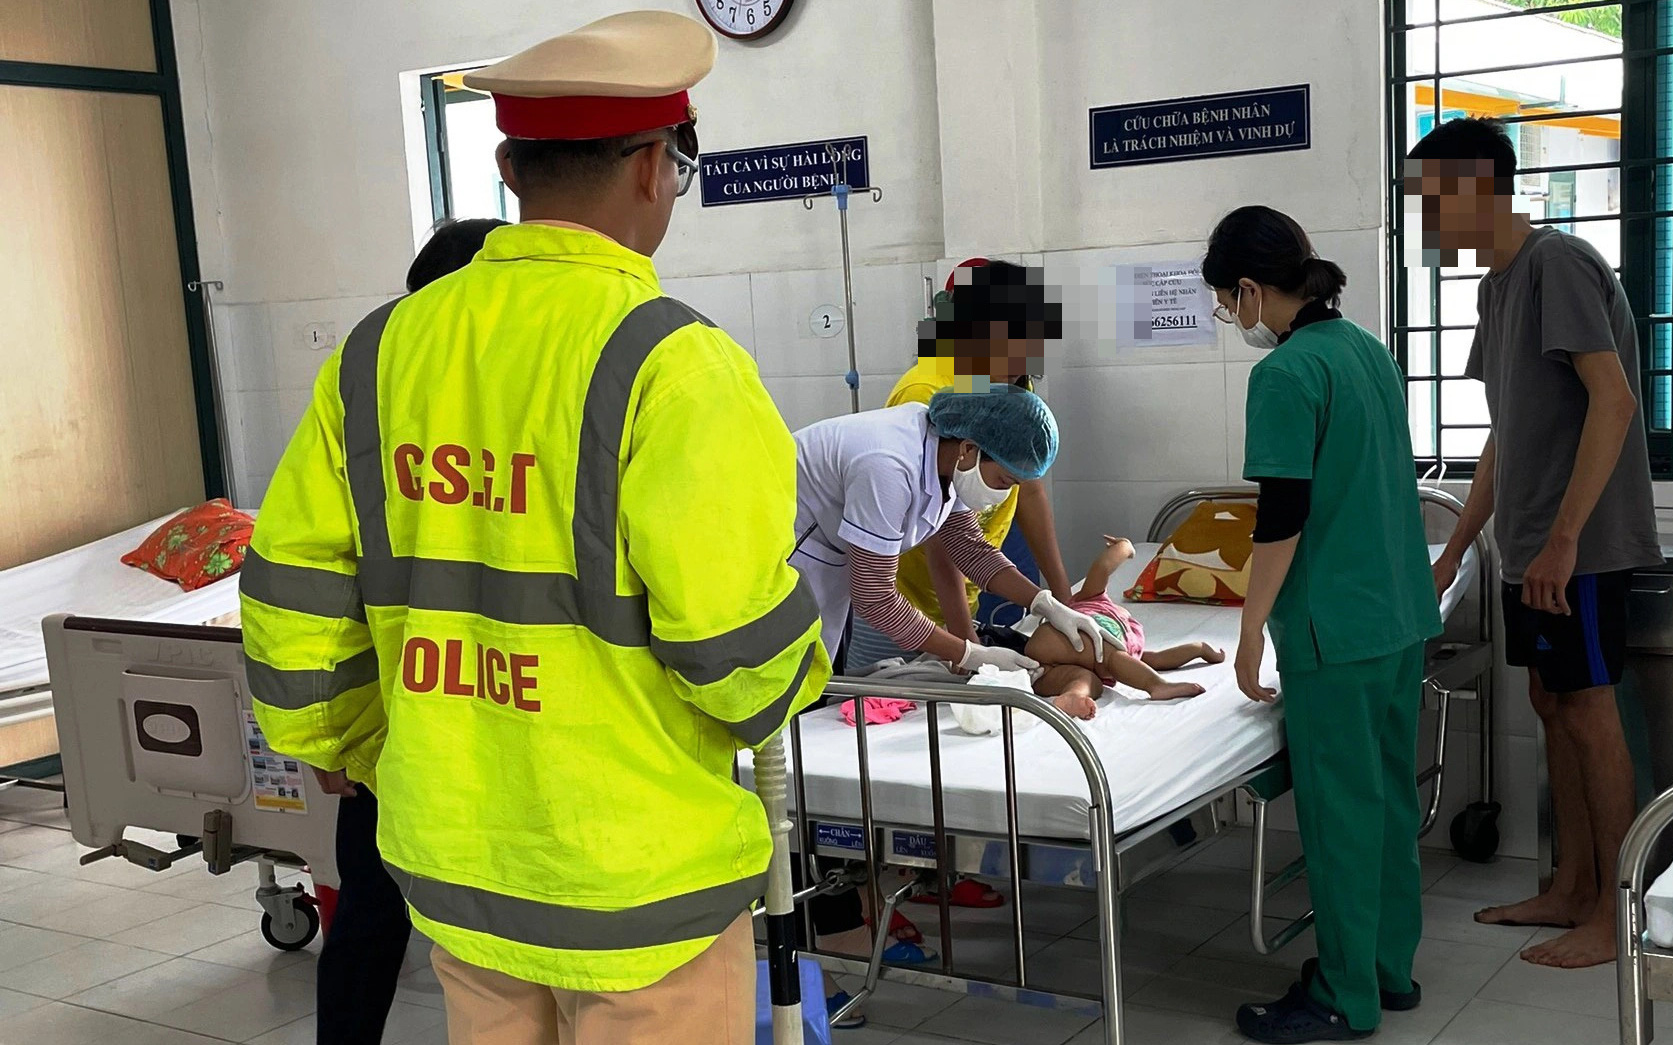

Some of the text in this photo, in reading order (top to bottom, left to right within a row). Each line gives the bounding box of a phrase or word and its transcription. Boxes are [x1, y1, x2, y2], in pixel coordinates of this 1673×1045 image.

[729, 6, 737, 23] 7
[746, 8, 755, 25] 6
[763, 0, 772, 16] 5
[1124, 102, 1271, 131] CỨU CHỮA BỆNH NHÂN
[1103, 121, 1295, 154] LÀ TRÁCH NHIỆM VÀ VINH DỰ
[754, 155, 768, 170] VÌ
[771, 154, 790, 171] SỰ
[793, 151, 818, 168] HÀI
[753, 174, 798, 192] NGƯỜI
[822, 314, 831, 329] 2
[402, 637, 541, 712] OLICE
